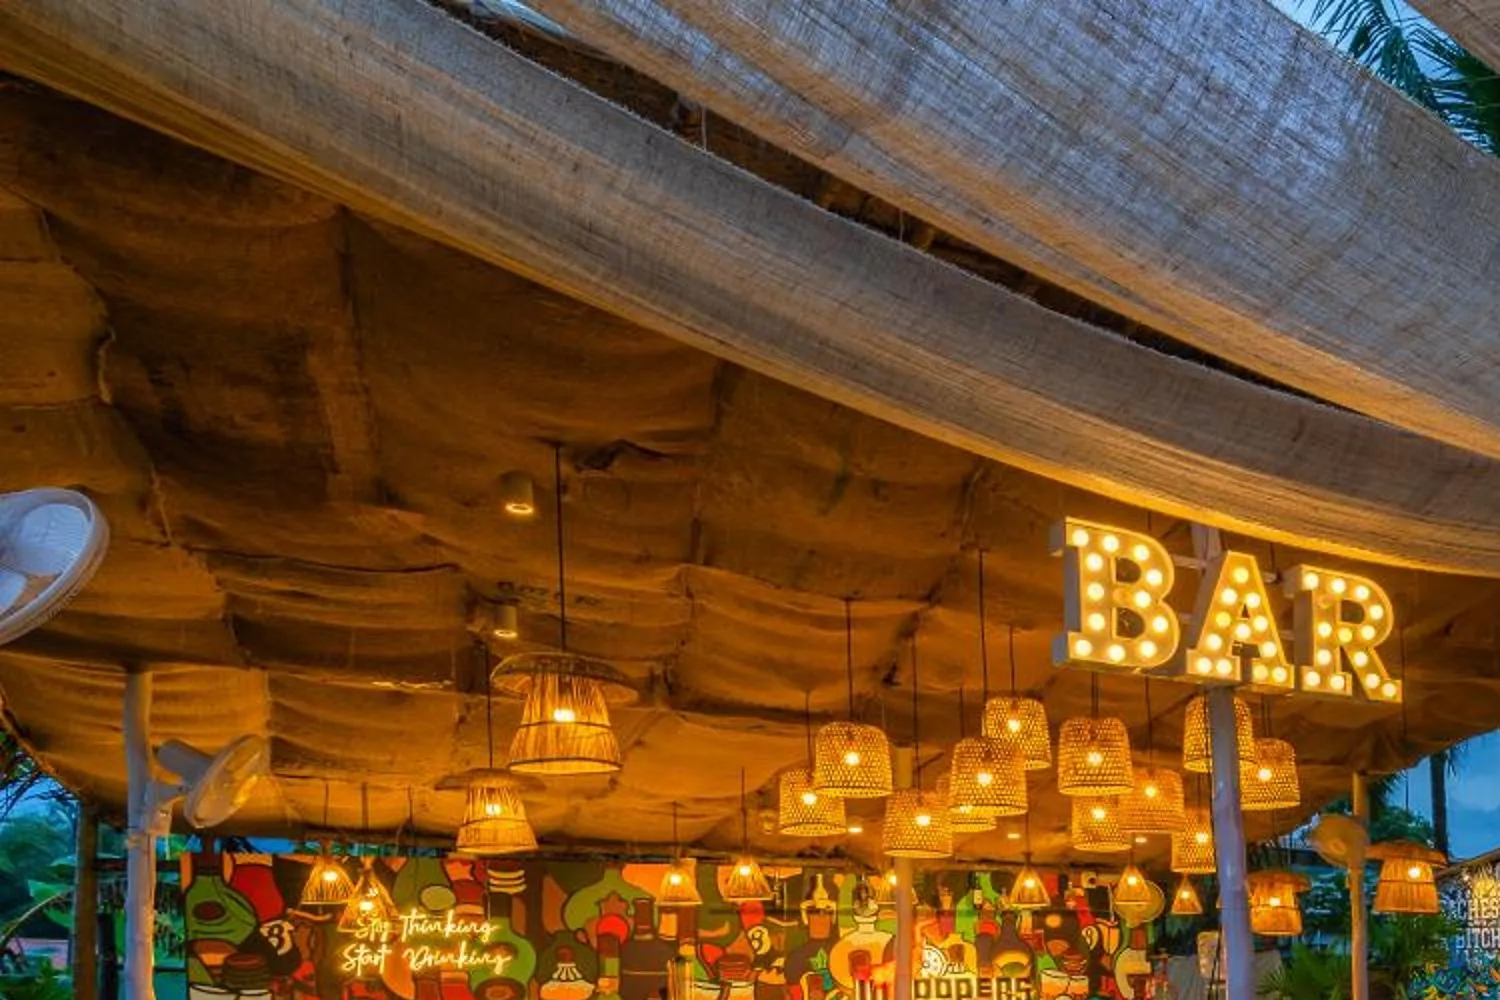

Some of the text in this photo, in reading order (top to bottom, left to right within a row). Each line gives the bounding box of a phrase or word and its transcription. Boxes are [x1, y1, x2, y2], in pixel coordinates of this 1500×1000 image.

[1054, 516, 1403, 703] BAR
[400, 907, 501, 943] Thinking
[341, 941, 513, 976] Start Drinking
